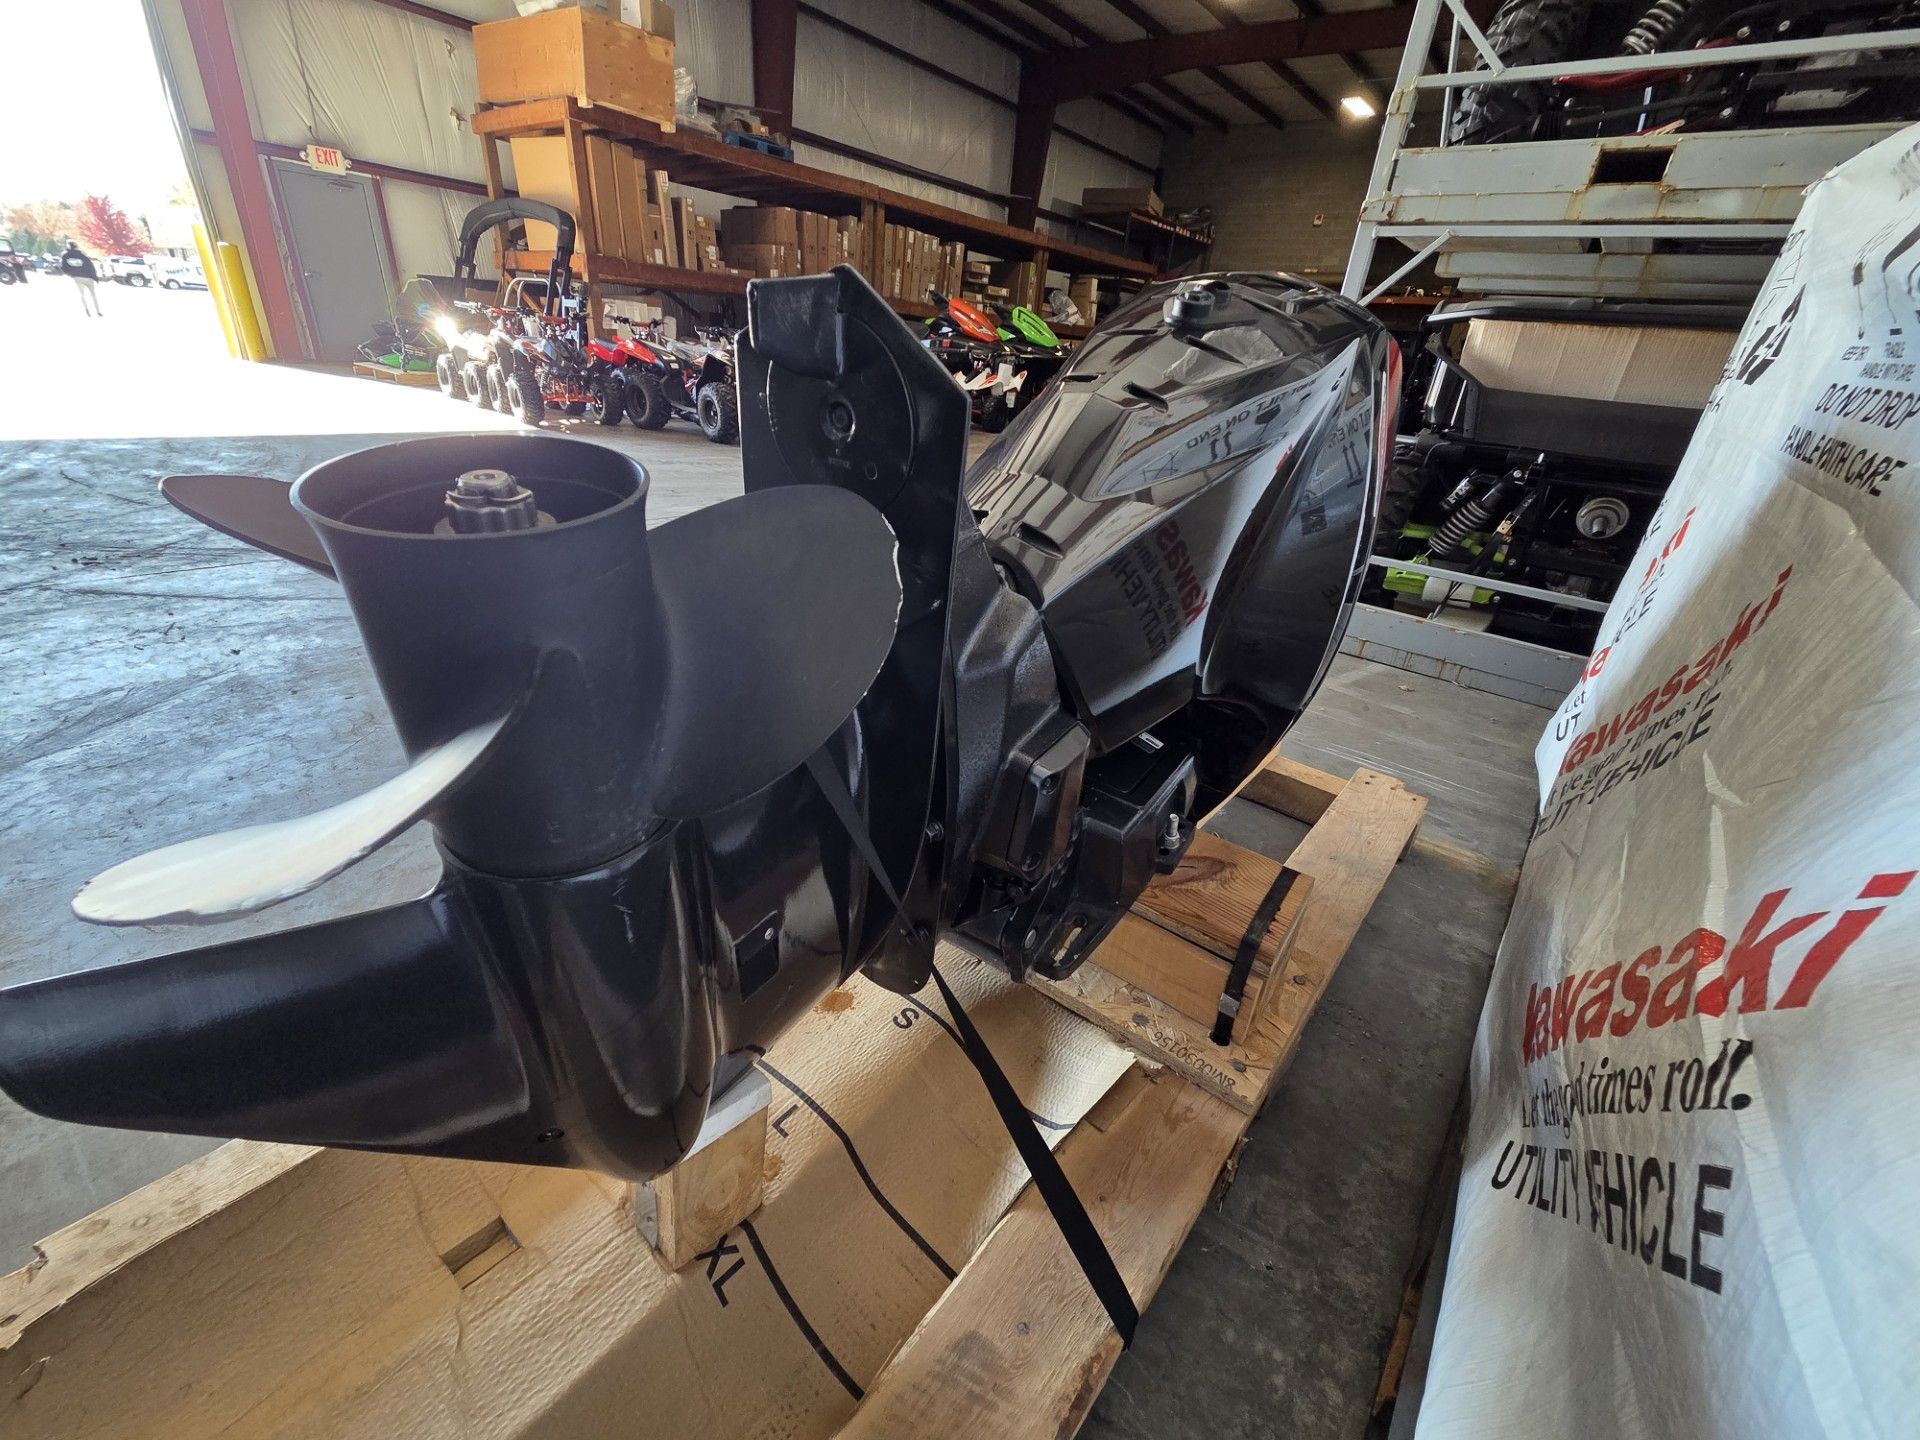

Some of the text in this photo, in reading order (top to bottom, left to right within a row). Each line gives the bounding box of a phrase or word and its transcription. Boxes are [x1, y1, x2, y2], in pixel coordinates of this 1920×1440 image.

[315, 148, 339, 167] EXIT
[1815, 383, 1920, 431] DO NOT DROP
[1844, 448, 1908, 497] CARE
[892, 1007, 920, 1030] S
[1586, 1056, 1656, 1114] times
[1660, 1038, 1754, 1114] roll.
[772, 1104, 800, 1139] L
[1491, 1140, 1582, 1226] UTILITY
[694, 1233, 746, 1308] XL
